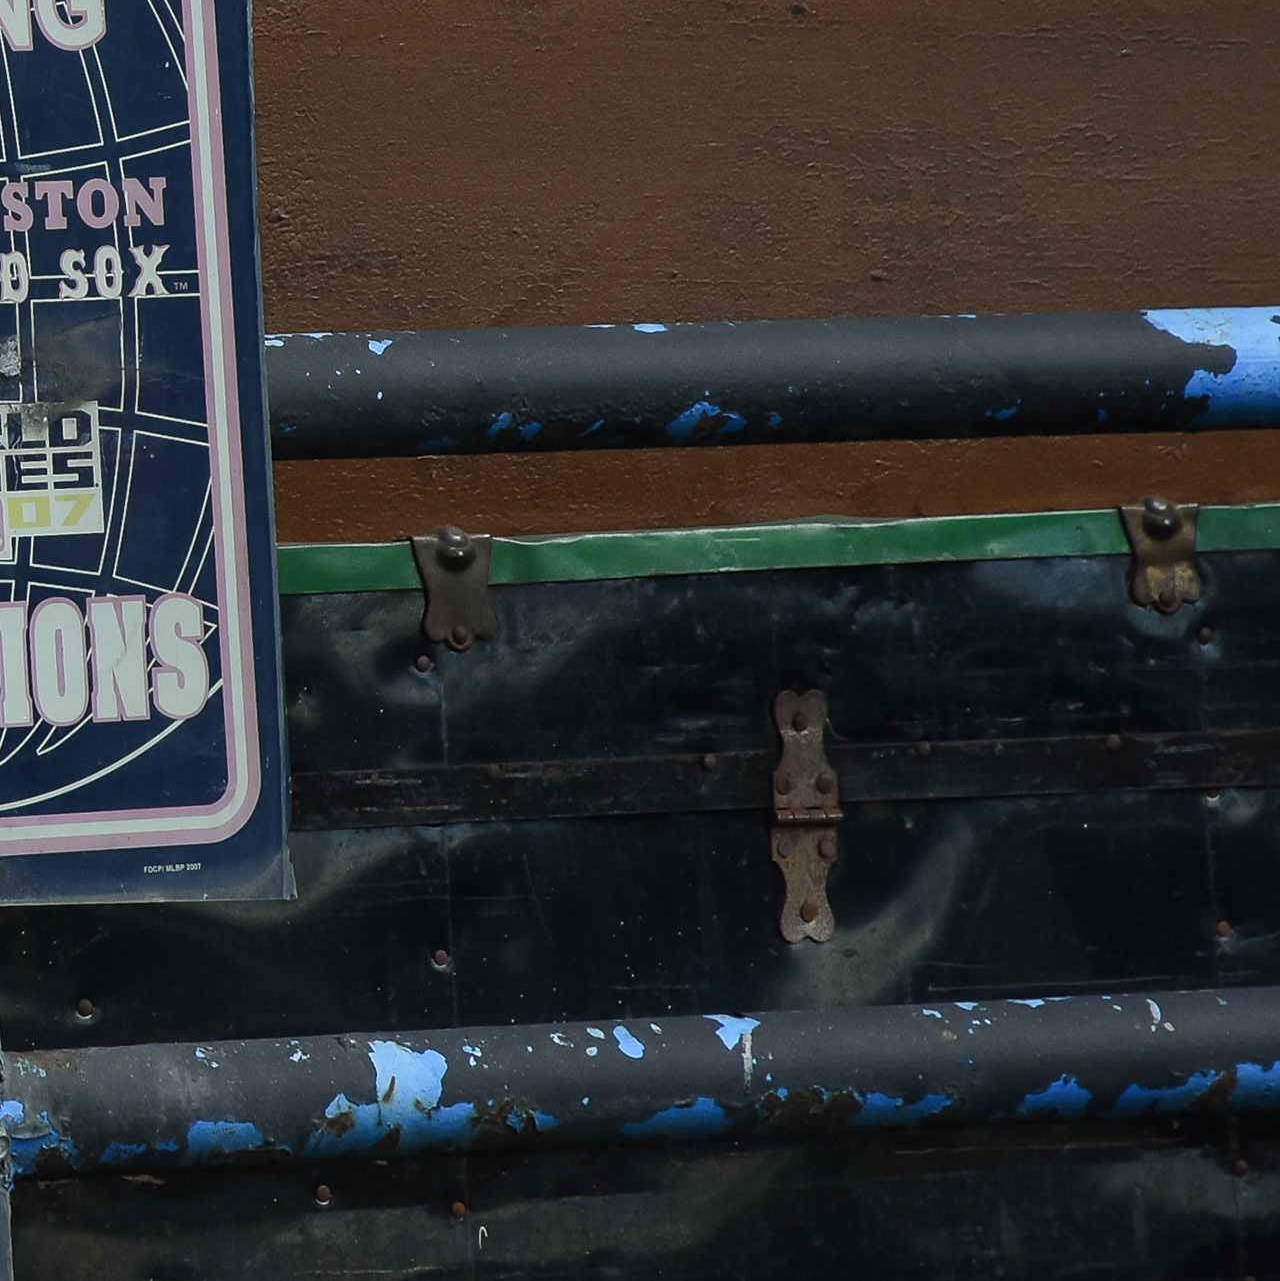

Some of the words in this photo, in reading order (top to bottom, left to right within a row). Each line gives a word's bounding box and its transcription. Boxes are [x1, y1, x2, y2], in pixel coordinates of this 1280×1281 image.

[58, 244, 171, 300] SOX
[7, 493, 96, 529] 07
[165, 863, 185, 872] MLBP
[186, 862, 202, 871] 2007
